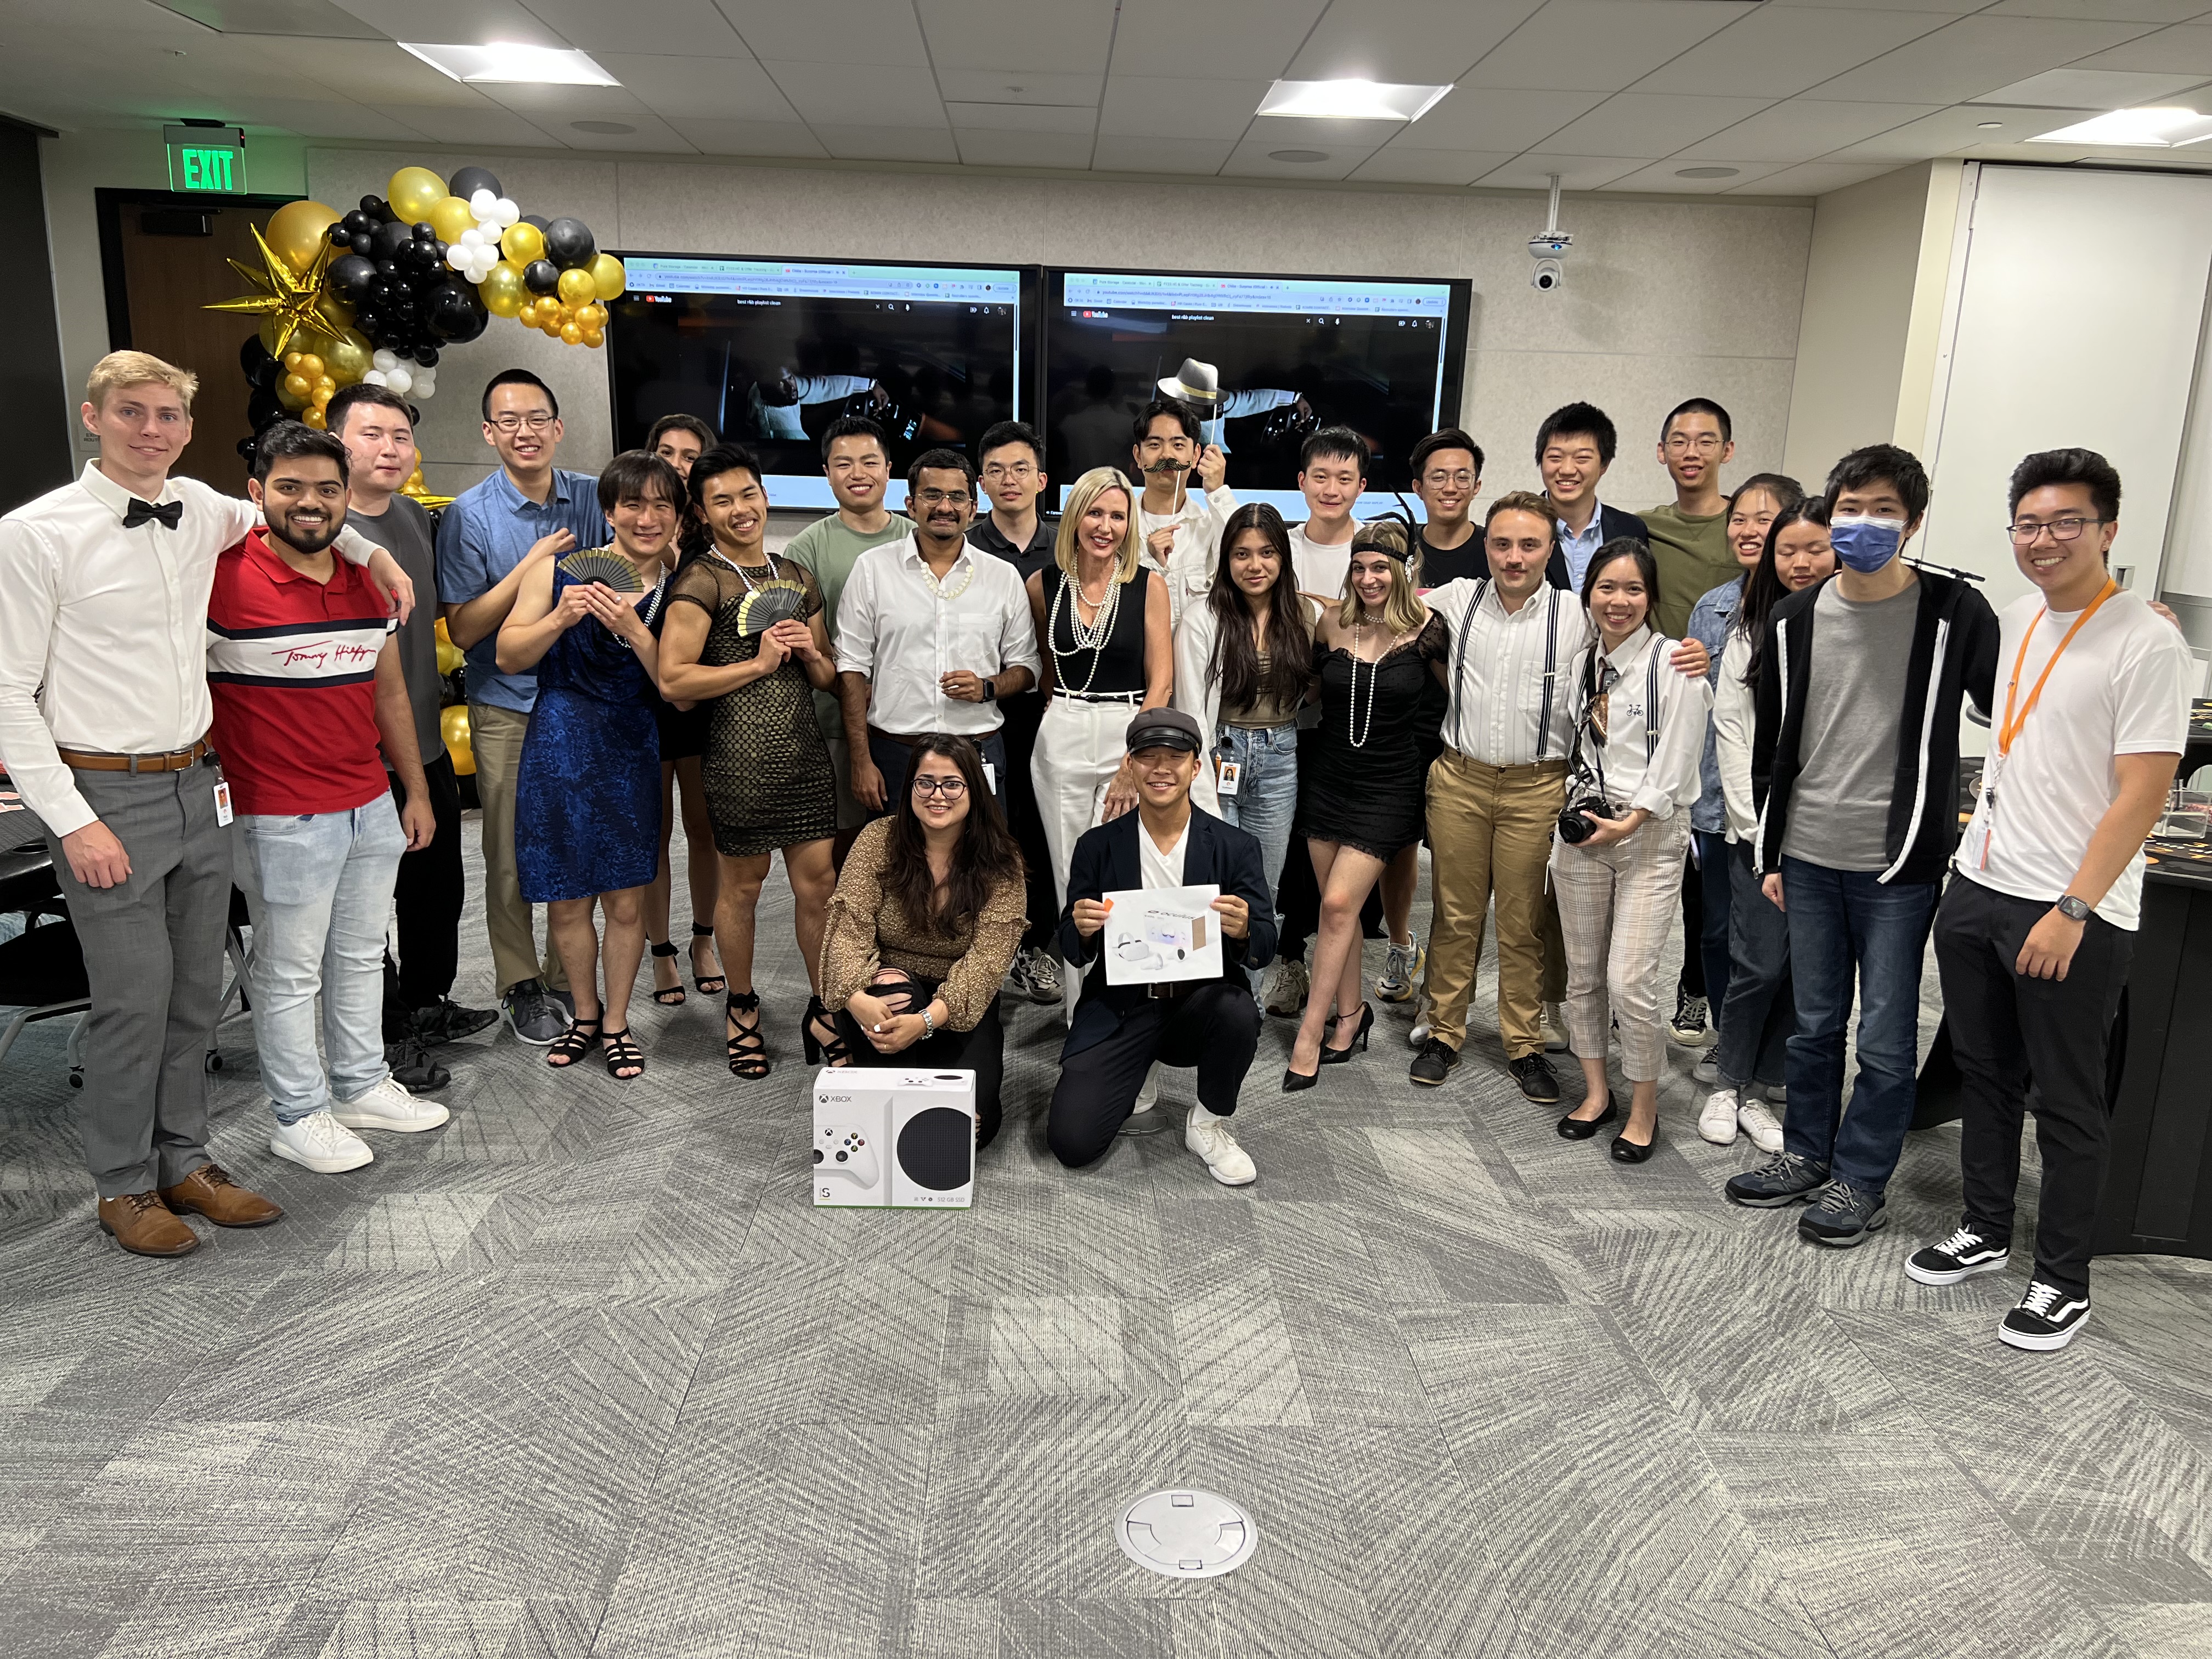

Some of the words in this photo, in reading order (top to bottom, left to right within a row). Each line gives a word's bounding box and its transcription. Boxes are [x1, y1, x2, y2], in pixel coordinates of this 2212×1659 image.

[182, 149, 234, 190] EXIT
[272, 640, 333, 669] Tommy
[822, 1188, 831, 1198] S
